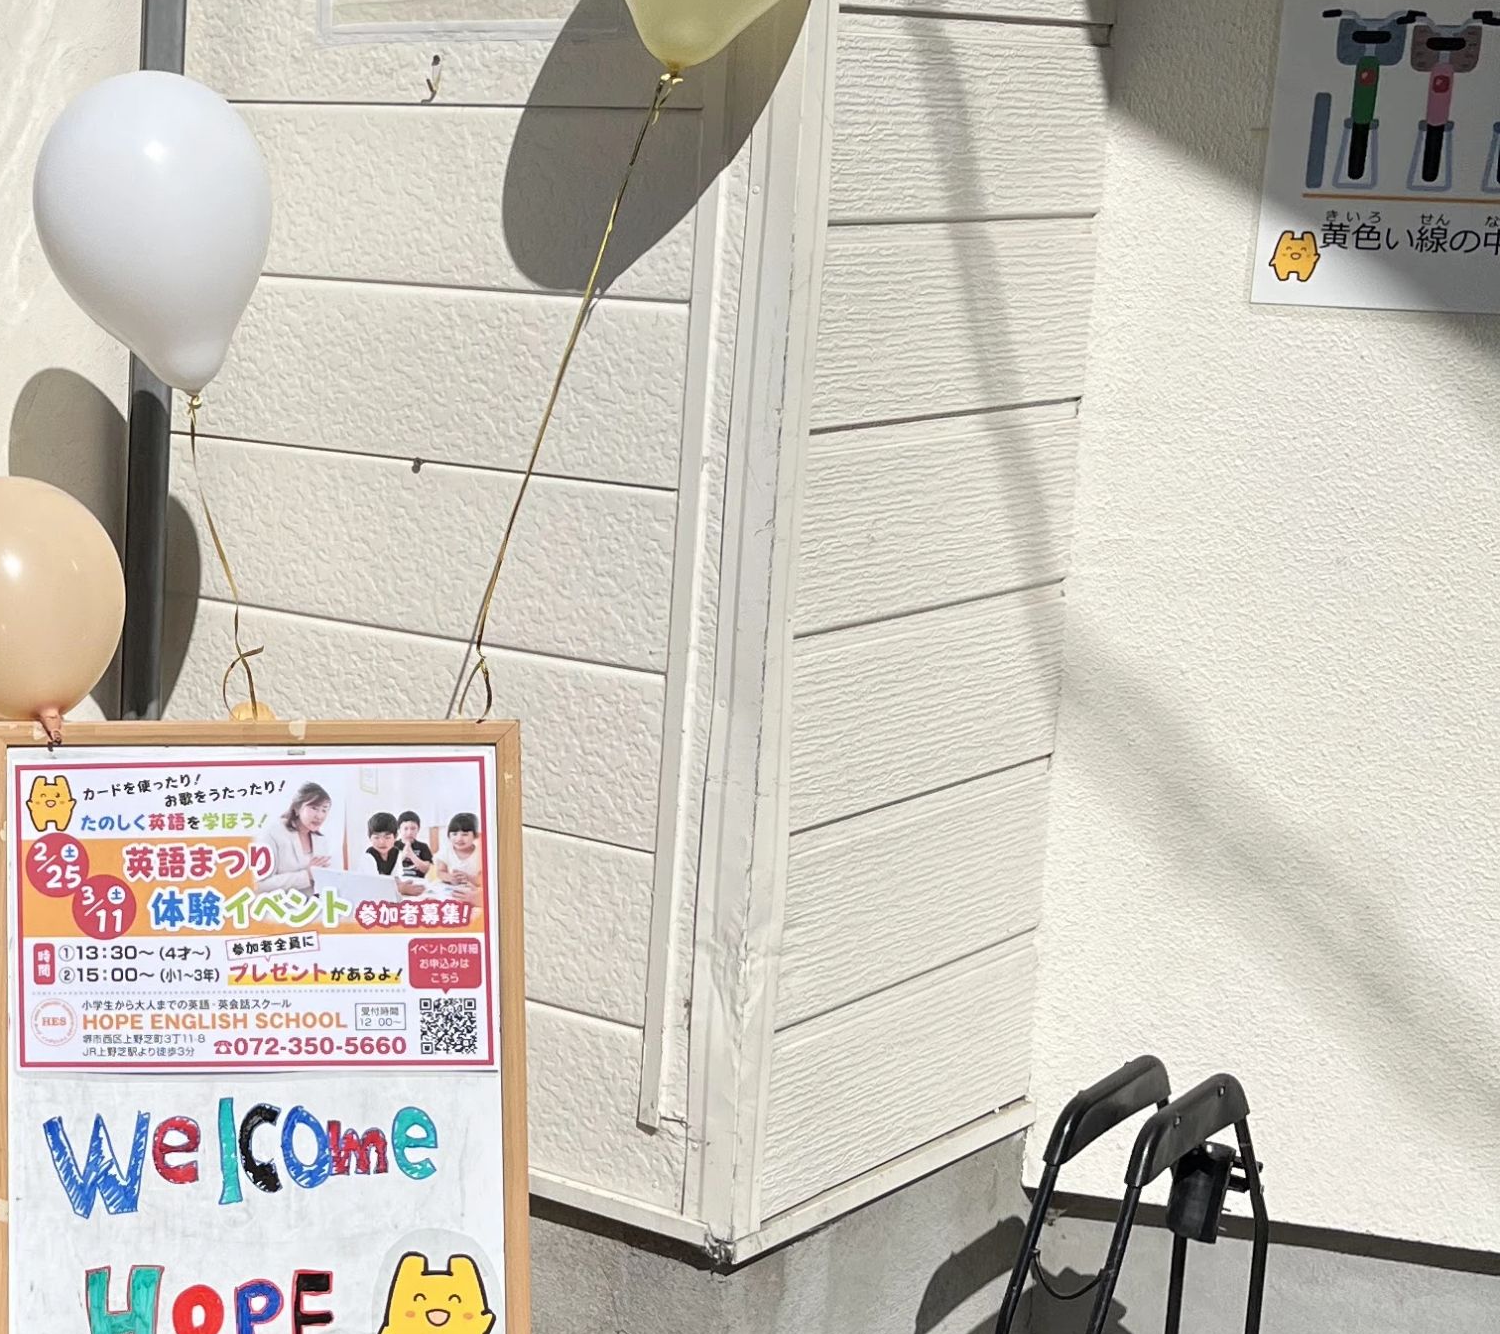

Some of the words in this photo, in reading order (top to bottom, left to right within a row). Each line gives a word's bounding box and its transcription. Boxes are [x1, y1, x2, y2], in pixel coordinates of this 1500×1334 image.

[1325, 210, 1381, 224] きいろ
[1420, 214, 1450, 226] せん
[125, 846, 272, 879] 英語まつり
[150, 889, 349, 927] 体験イベント
[231, 935, 315, 956] 参加者全員に
[410, 942, 479, 955] イベントの詳細
[36, 949, 51, 978] 時間
[419, 958, 469, 970] お申込みは
[430, 972, 459, 984] こちら
[360, 1007, 399, 1017] 受付時間
[83, 1014, 143, 1030] HOPE
[151, 1013, 247, 1030] ENGLISH
[256, 1012, 348, 1029] SCHOOL
[233, 1036, 407, 1055] 072-350-5660
